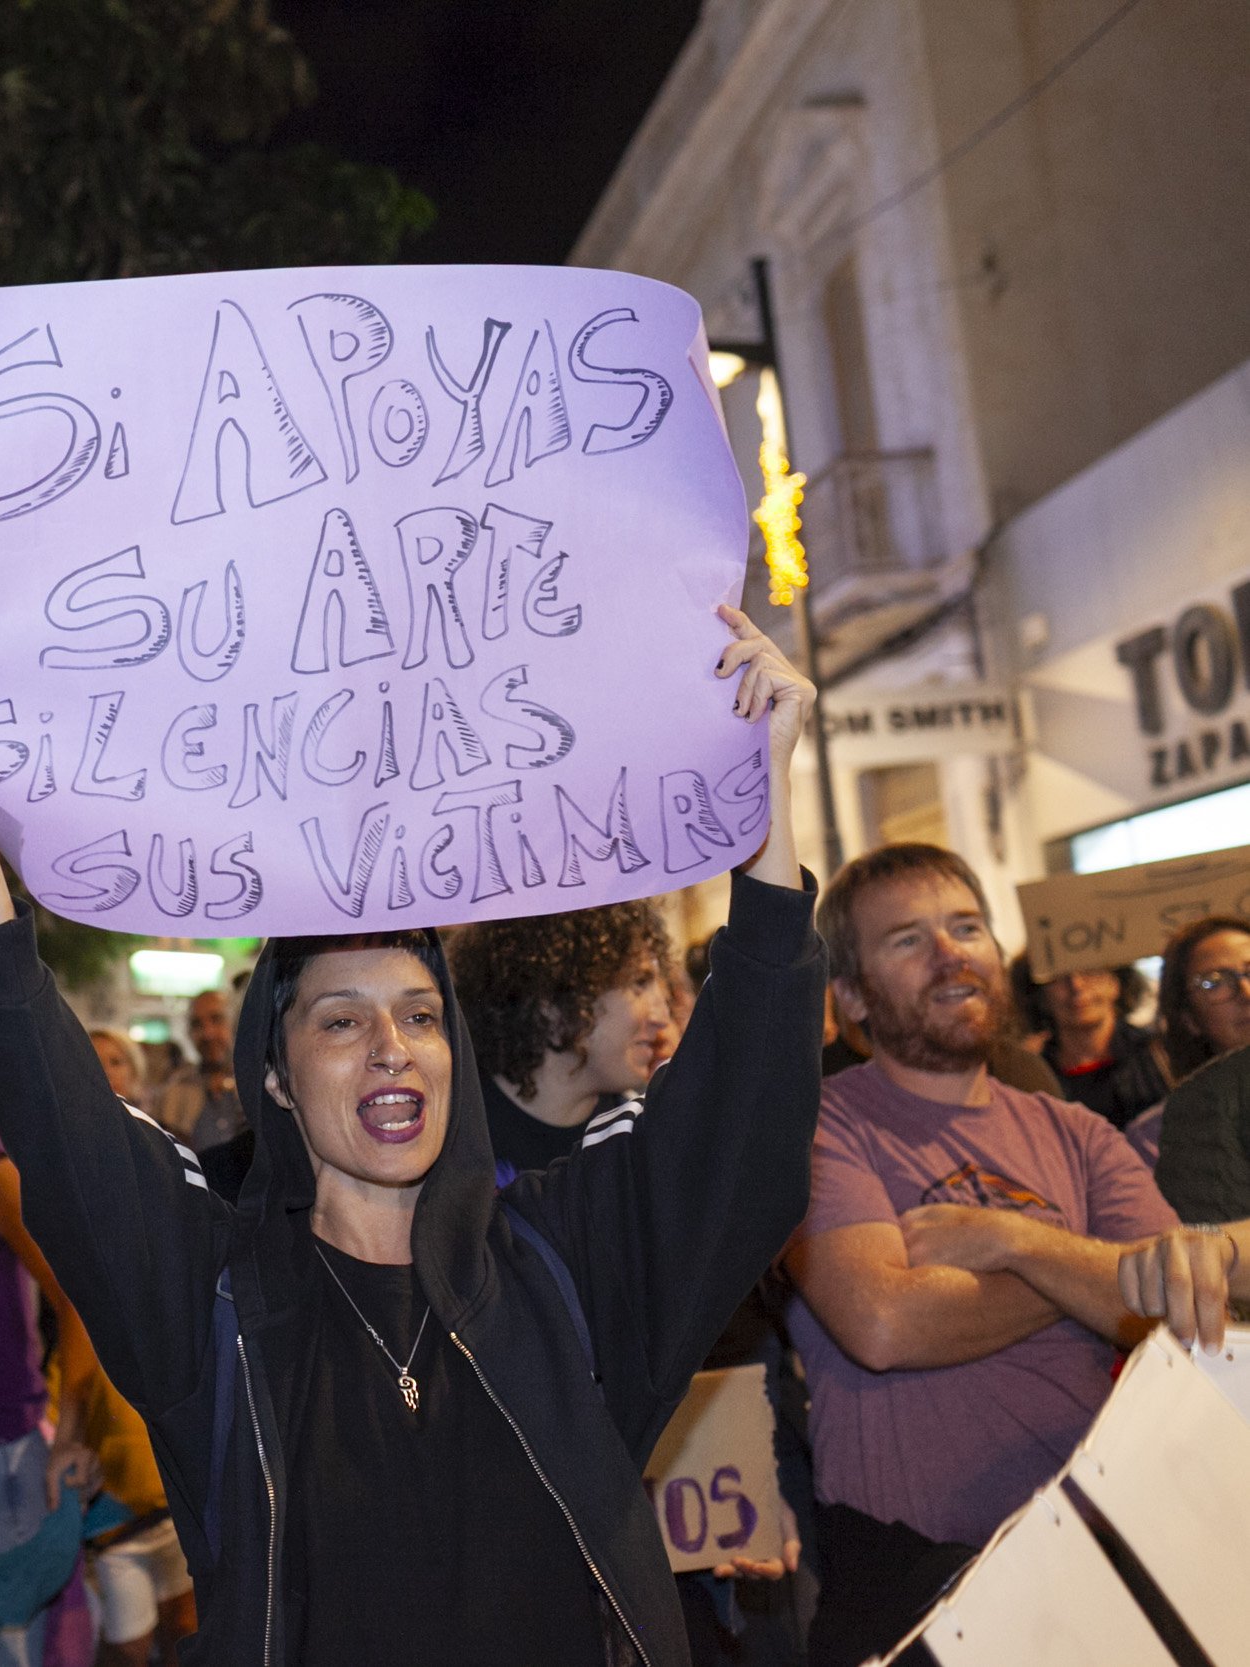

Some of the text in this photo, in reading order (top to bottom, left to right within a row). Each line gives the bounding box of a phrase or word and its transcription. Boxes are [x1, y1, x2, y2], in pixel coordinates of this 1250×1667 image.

[170, 291, 674, 526] APOYAS
[38, 502, 583, 682] SU ARTE
[806, 707, 872, 738] OM
[37, 828, 265, 920] SUS
[643, 1464, 759, 1555] OS
